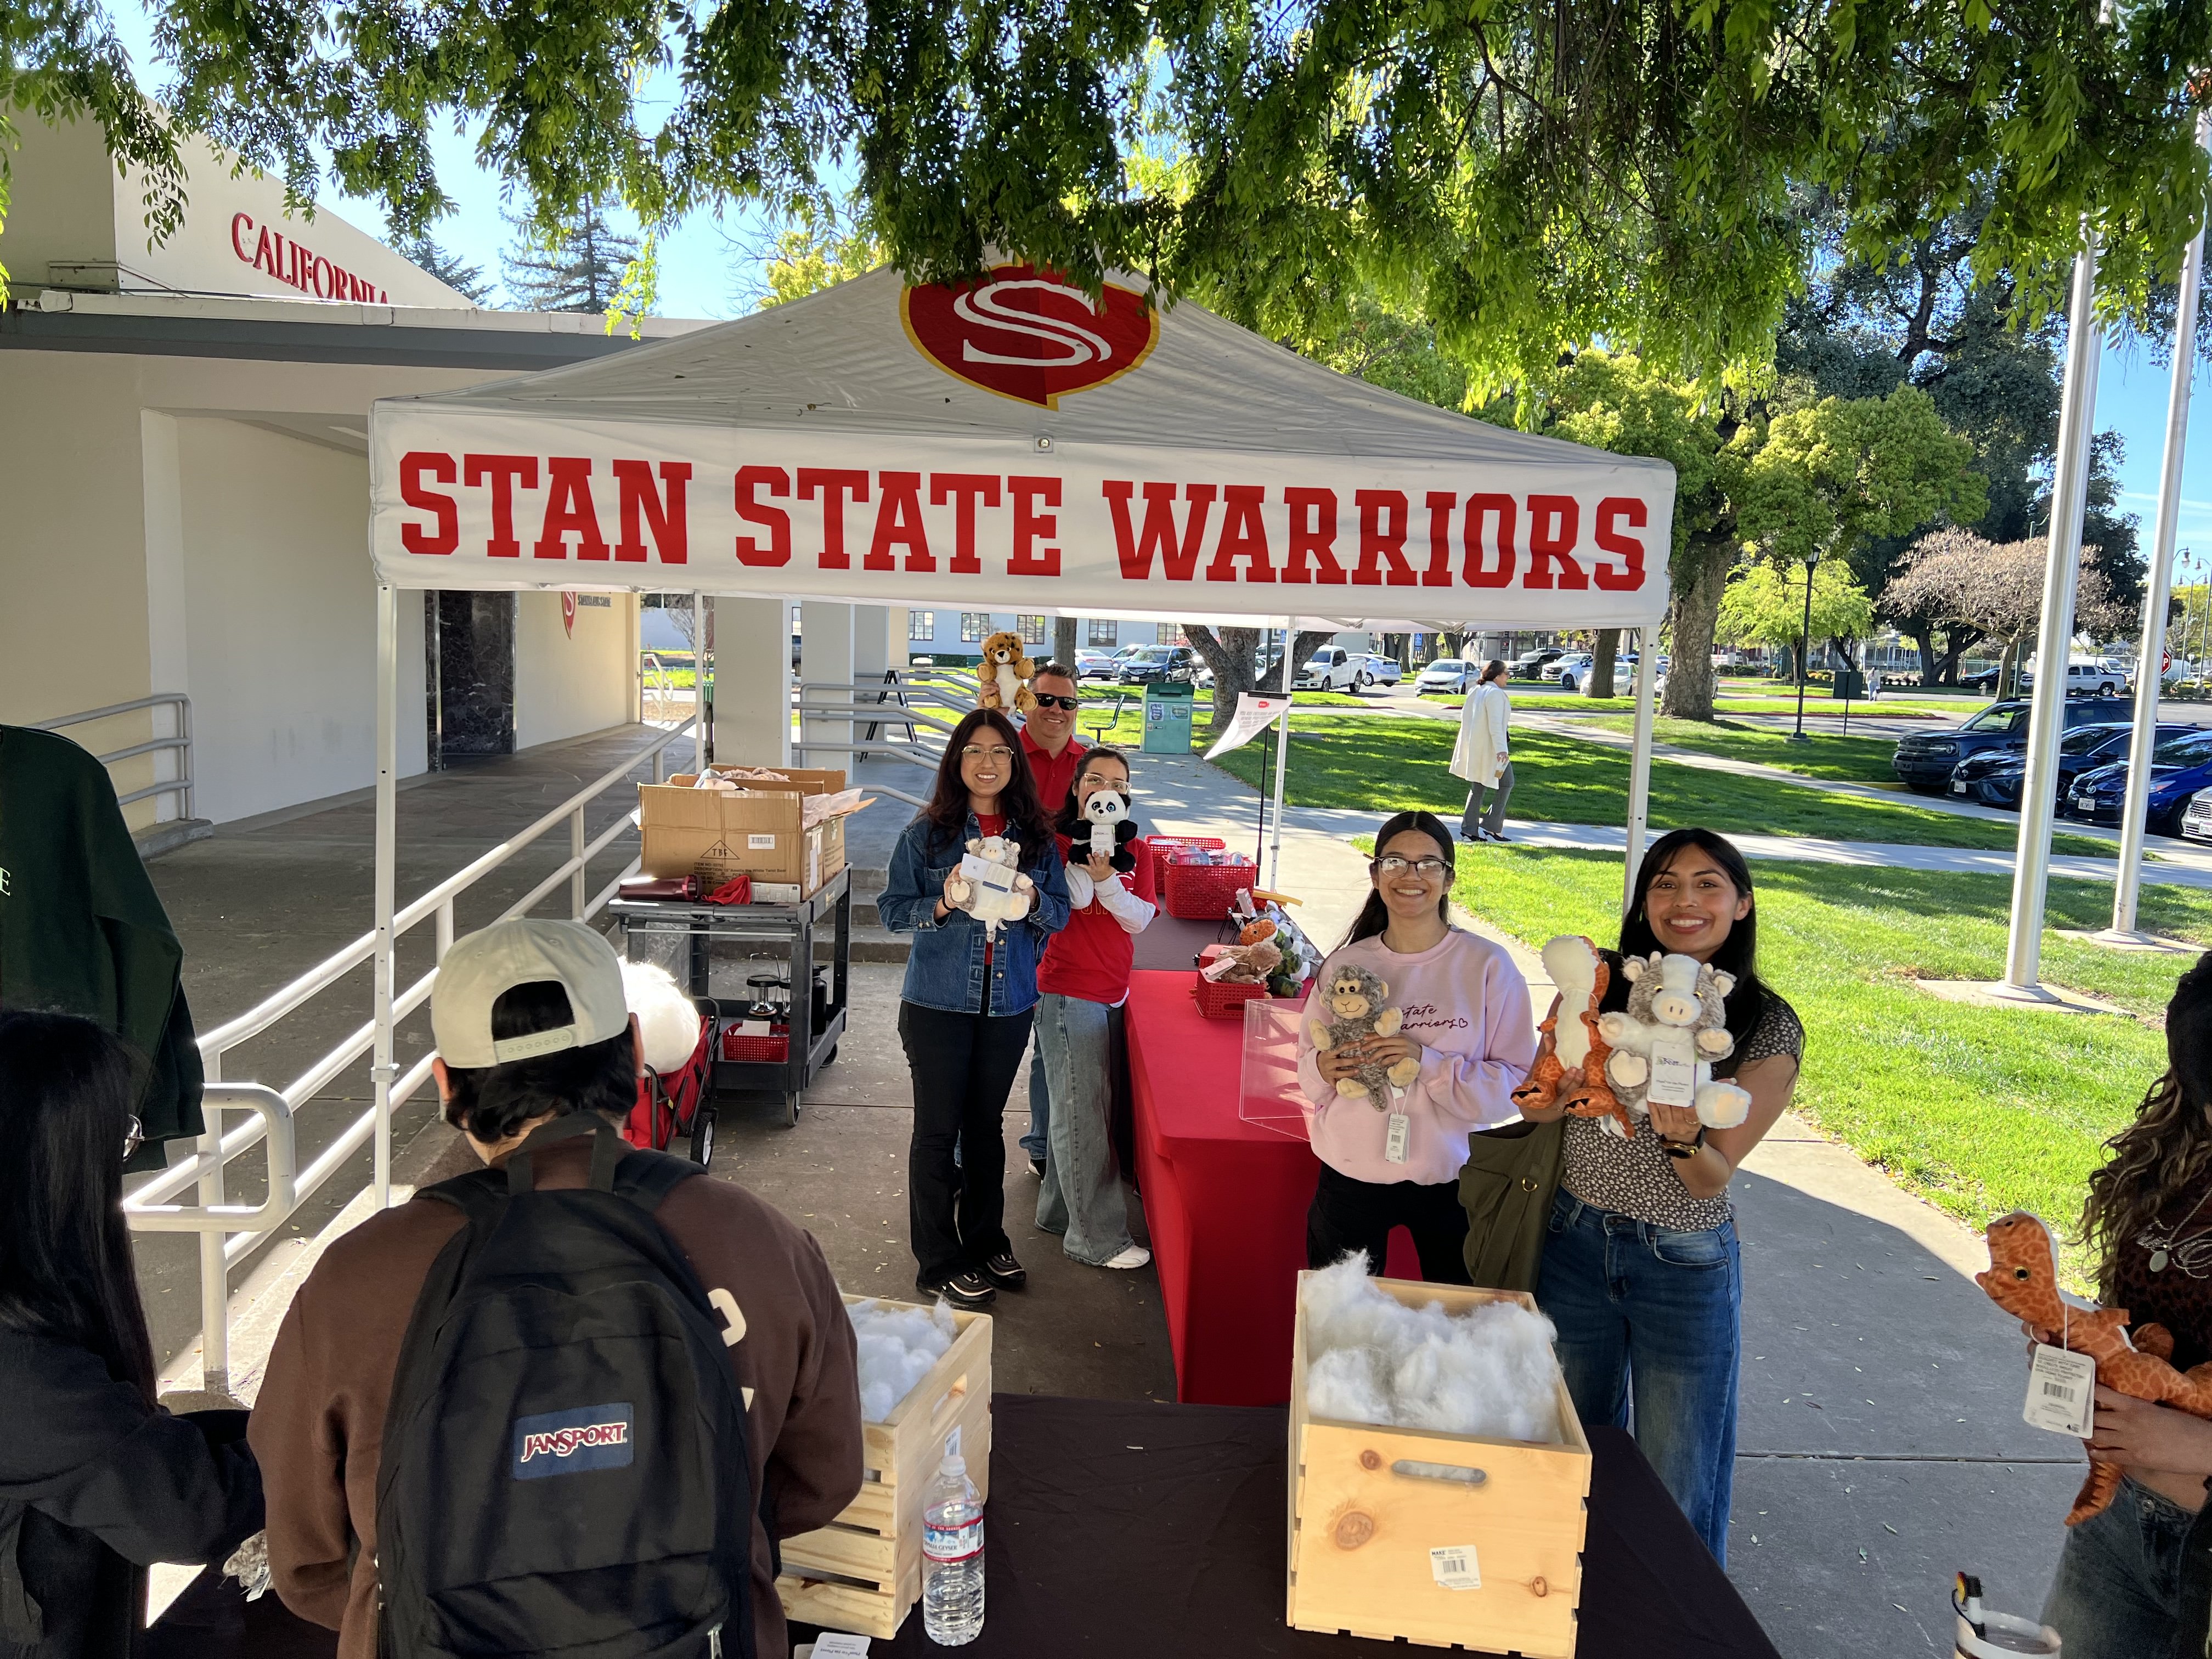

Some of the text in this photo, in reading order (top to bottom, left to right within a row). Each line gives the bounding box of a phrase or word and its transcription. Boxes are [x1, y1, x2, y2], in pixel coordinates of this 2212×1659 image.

[399, 452, 1647, 591] STAN STATE WARRIORS
[1400, 1019, 1458, 1030] arriors
[521, 1422, 627, 1463] JANSPORT
